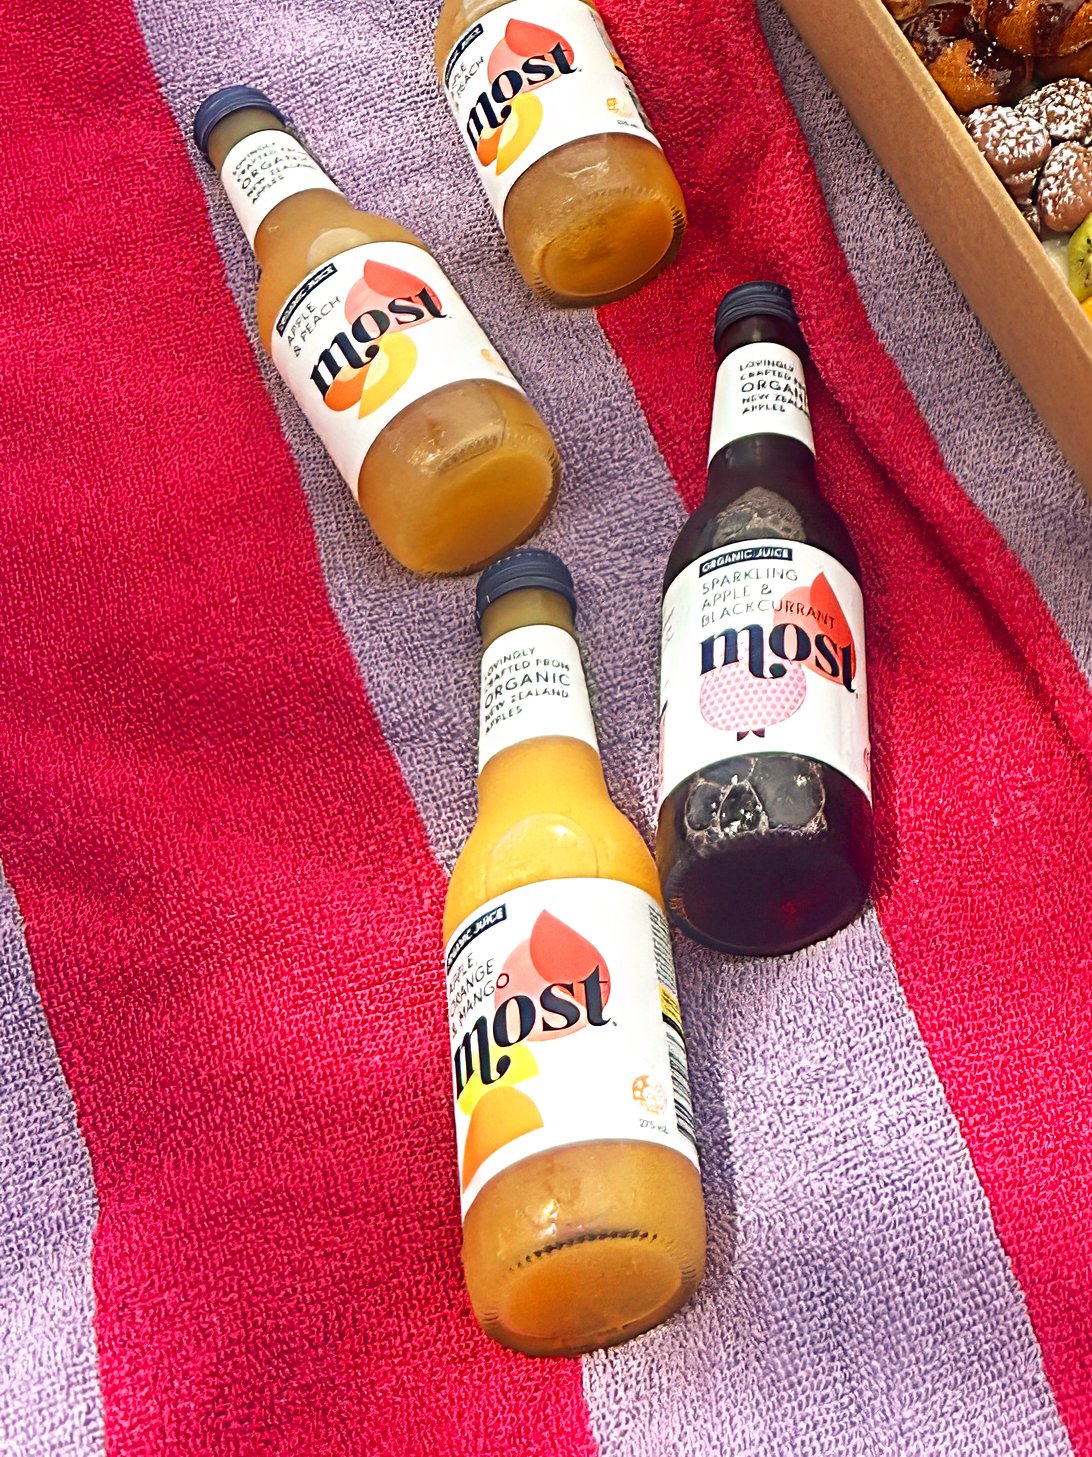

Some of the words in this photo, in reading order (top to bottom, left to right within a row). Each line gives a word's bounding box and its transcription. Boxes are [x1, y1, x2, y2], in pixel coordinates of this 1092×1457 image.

[466, 42, 578, 154] most
[286, 301, 317, 345] APPLE
[300, 296, 341, 343] PEACH
[310, 287, 448, 404] most
[701, 549, 753, 573] ORGANIC
[755, 545, 789, 559] JUICE
[702, 566, 798, 596] SPARKLING
[700, 598, 835, 630] BLACKCURRANT
[701, 585, 751, 611] APPLE
[760, 583, 773, 595] &
[699, 622, 857, 693] most
[484, 670, 571, 709] ORGANIC
[458, 972, 510, 1025] MANGO
[454, 964, 612, 1102] most
